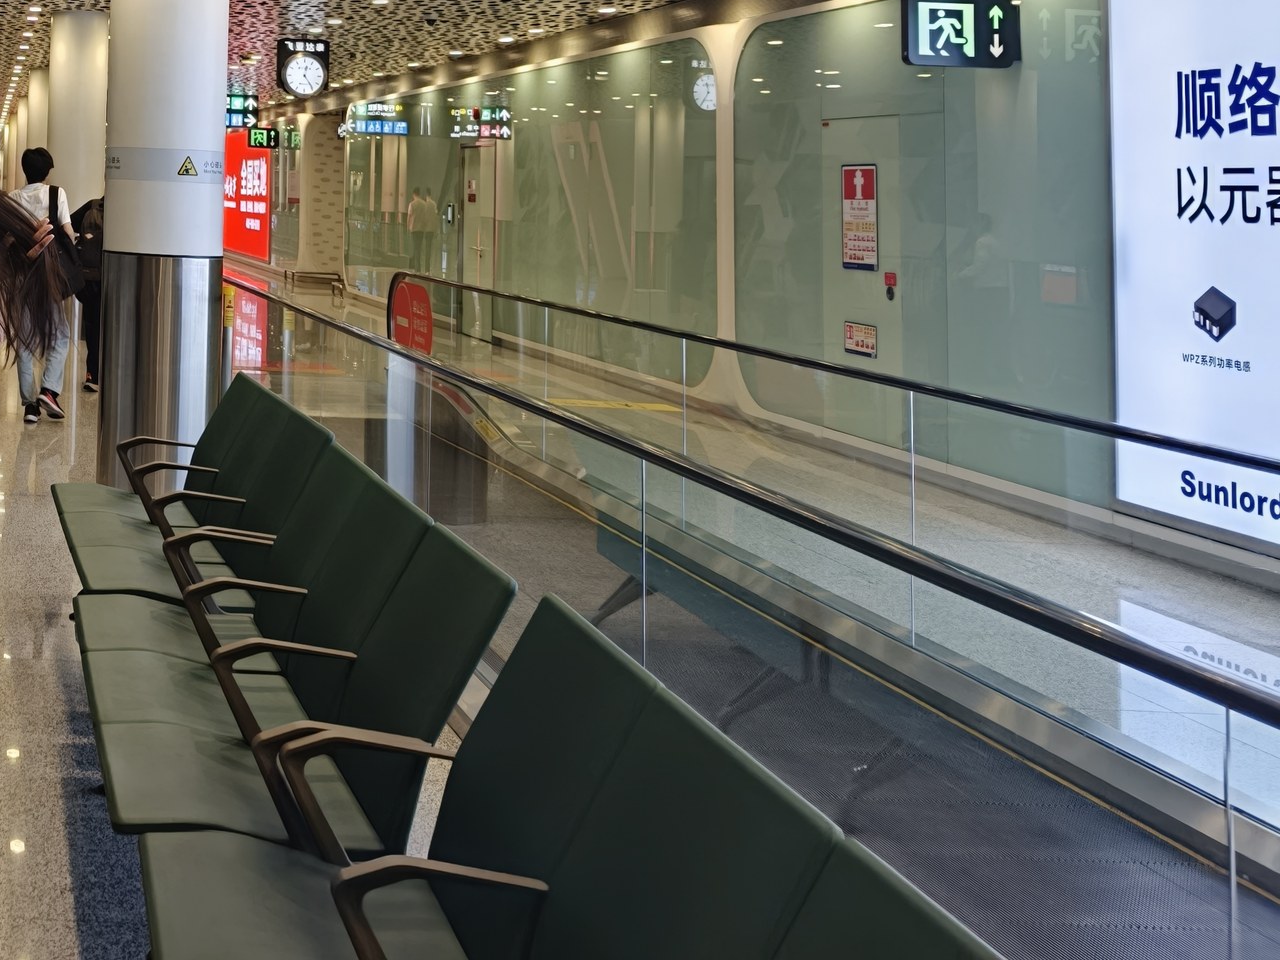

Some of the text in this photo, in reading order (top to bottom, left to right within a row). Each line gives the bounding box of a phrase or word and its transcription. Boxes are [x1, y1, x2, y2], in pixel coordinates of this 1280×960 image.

[1175, 61, 1280, 140] 顺络
[1182, 353, 1251, 372] WPZ系列功率电感
[1181, 470, 1280, 520] Sunlord
